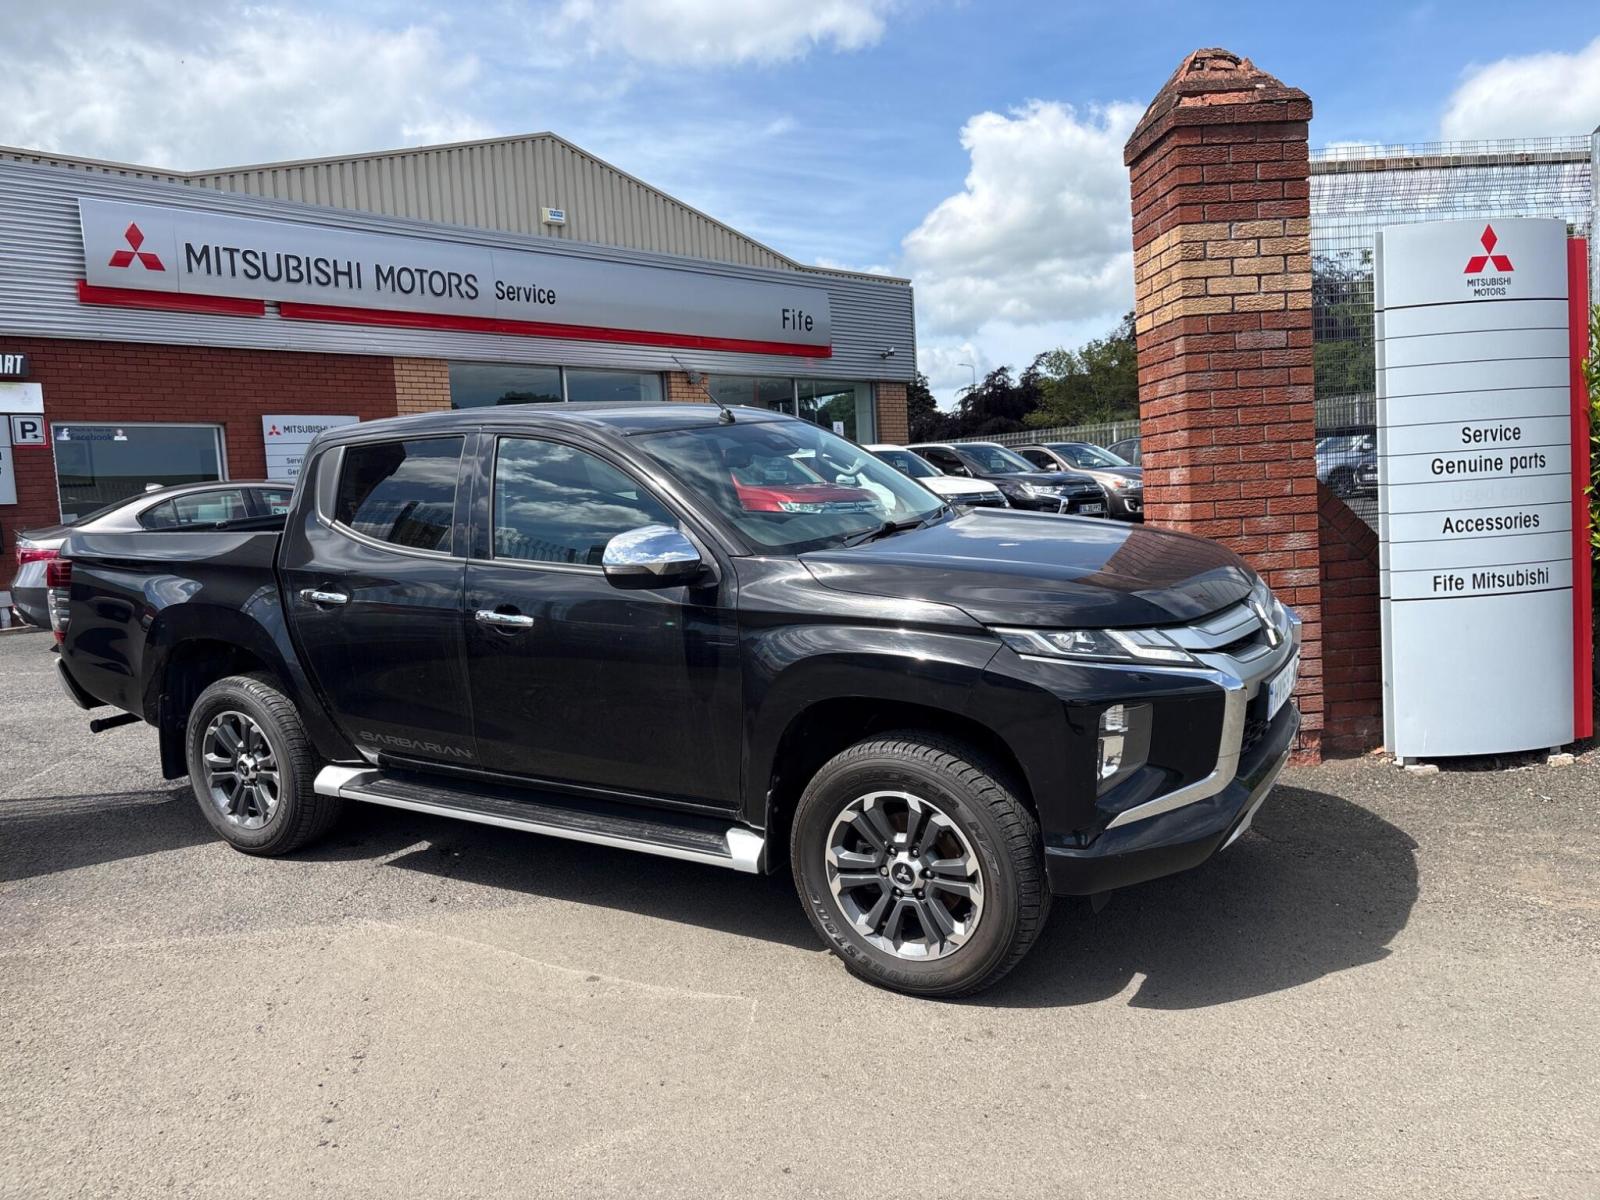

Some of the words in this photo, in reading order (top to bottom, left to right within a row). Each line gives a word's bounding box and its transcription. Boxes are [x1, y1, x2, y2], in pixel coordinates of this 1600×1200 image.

[185, 242, 362, 289] MITSUBISHI
[375, 263, 479, 300] MOTORS
[495, 280, 556, 305] Service
[782, 308, 814, 332] Fife
[1467, 277, 1511, 287] MITSUBISHI
[1473, 287, 1506, 296] MOTORS
[1462, 425, 1521, 444] Service
[1431, 455, 1504, 475] Genuine
[1510, 452, 1546, 474] parts
[1442, 512, 1540, 534] Accessories
[1433, 574, 1465, 592] Fife
[1472, 567, 1549, 590] Mitsubishi
[360, 730, 473, 759] BARBARIAN
